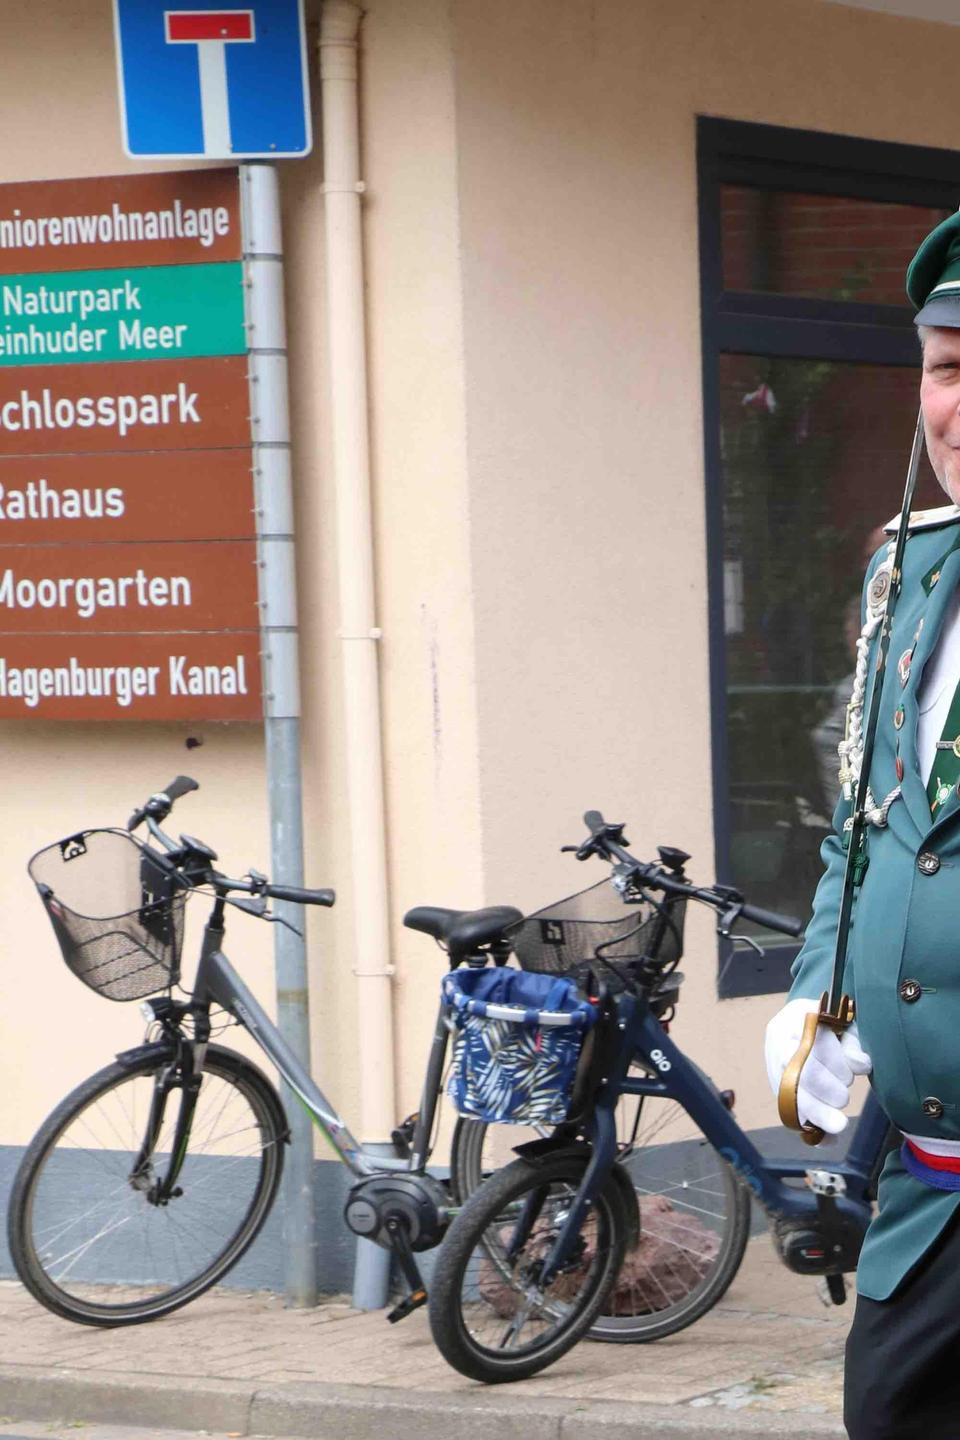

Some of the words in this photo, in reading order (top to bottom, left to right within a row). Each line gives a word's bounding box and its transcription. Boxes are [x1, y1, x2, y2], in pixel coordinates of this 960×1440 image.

[3, 281, 142, 320] Naturpark
[119, 319, 188, 350] Meer
[0, 382, 201, 437] chlosspark
[168, 655, 248, 696] Kanal
